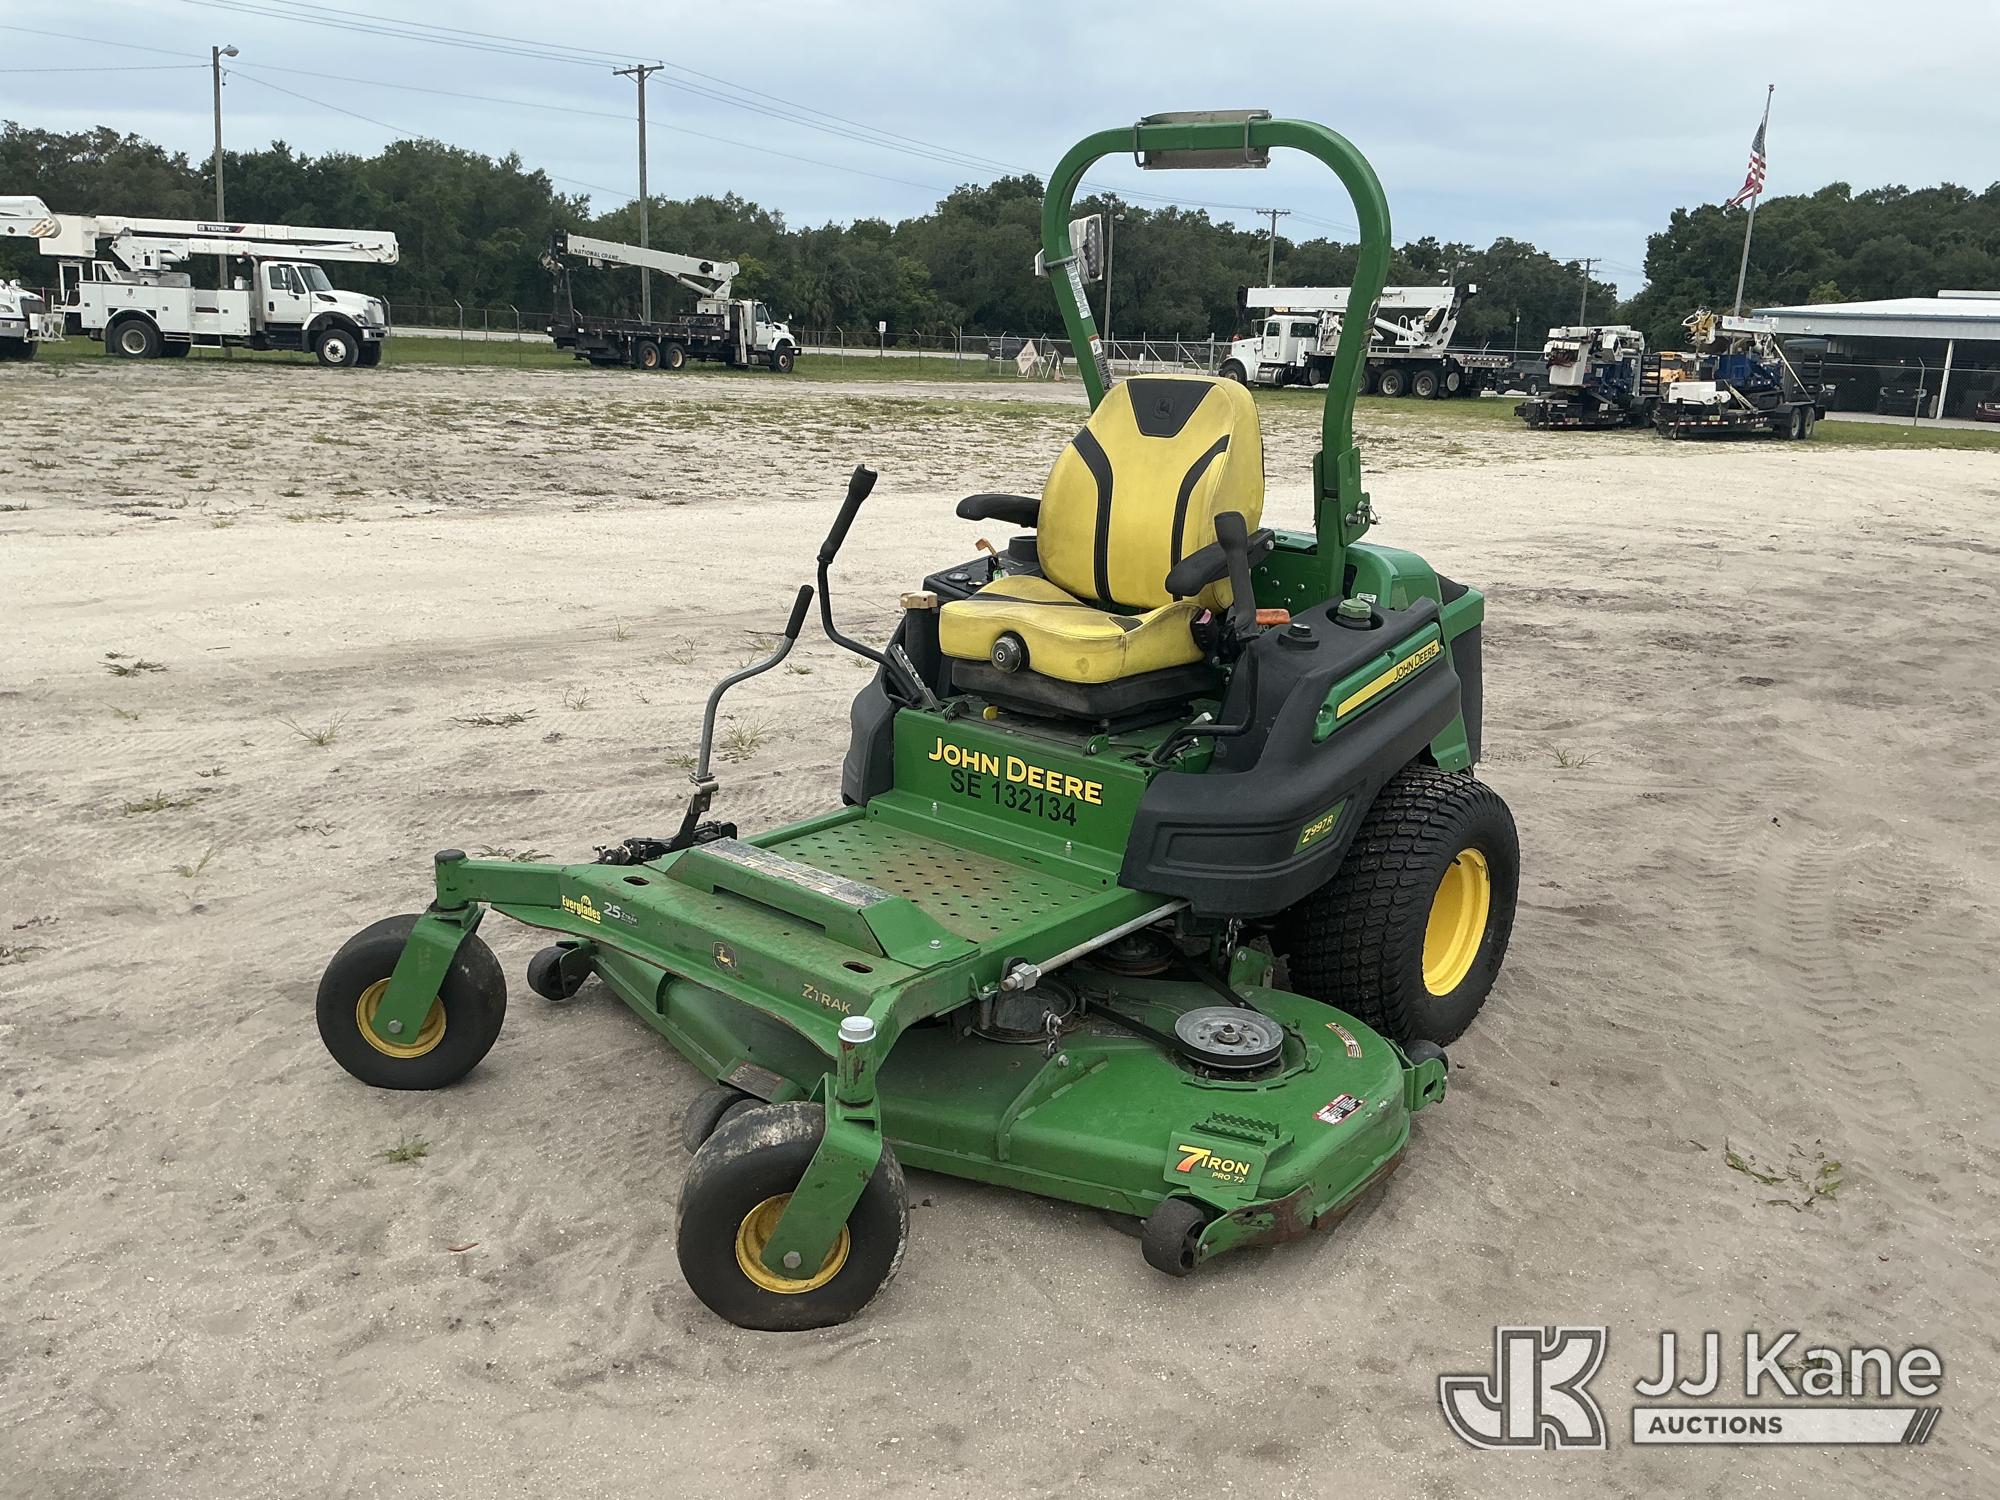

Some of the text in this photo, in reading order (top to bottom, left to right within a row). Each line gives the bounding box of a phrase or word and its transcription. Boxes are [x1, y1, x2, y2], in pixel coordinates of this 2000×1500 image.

[573, 249, 619, 261] NATIONAL CRANE
[1394, 644, 1437, 681] JOHN DEERE
[928, 737, 1103, 806] JOHN DEERE
[950, 769, 1077, 827] SE 132134
[1302, 814, 1334, 844] Z997R
[561, 895, 601, 921] Everglades
[603, 901, 621, 919] 25
[1211, 1171, 1231, 1181] PRO
